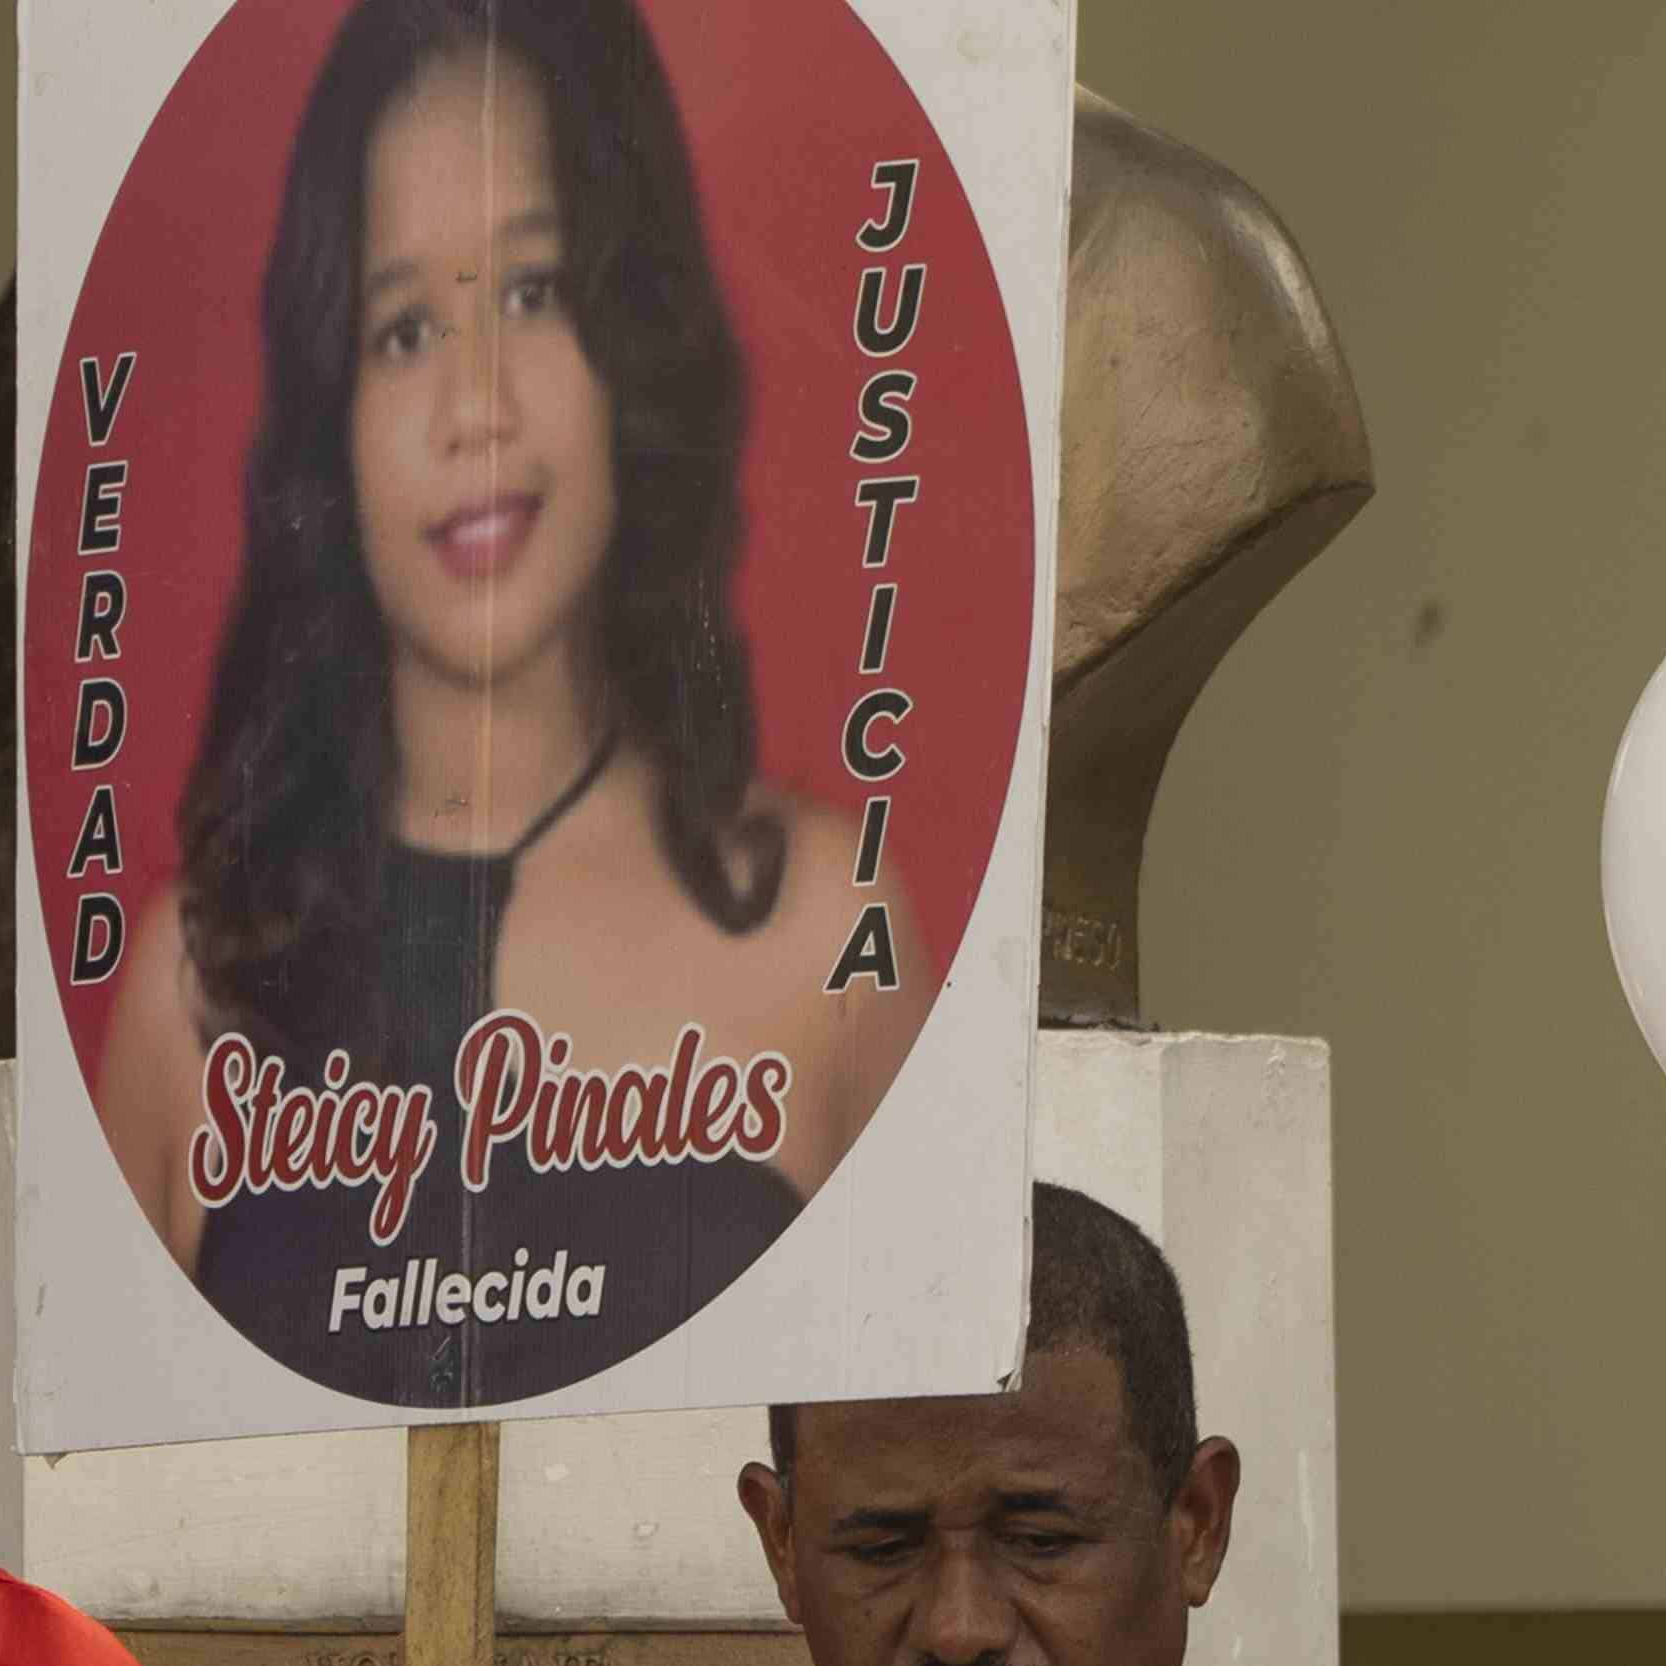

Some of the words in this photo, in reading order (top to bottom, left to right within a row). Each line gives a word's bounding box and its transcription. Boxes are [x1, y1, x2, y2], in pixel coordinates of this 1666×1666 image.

[66, 351, 137, 985] VERDAD
[823, 159, 925, 992] JUSTICIA
[190, 1030, 438, 1246] Steicy
[453, 1007, 793, 1194] Pinales
[326, 1247, 608, 1334] Fallecida
